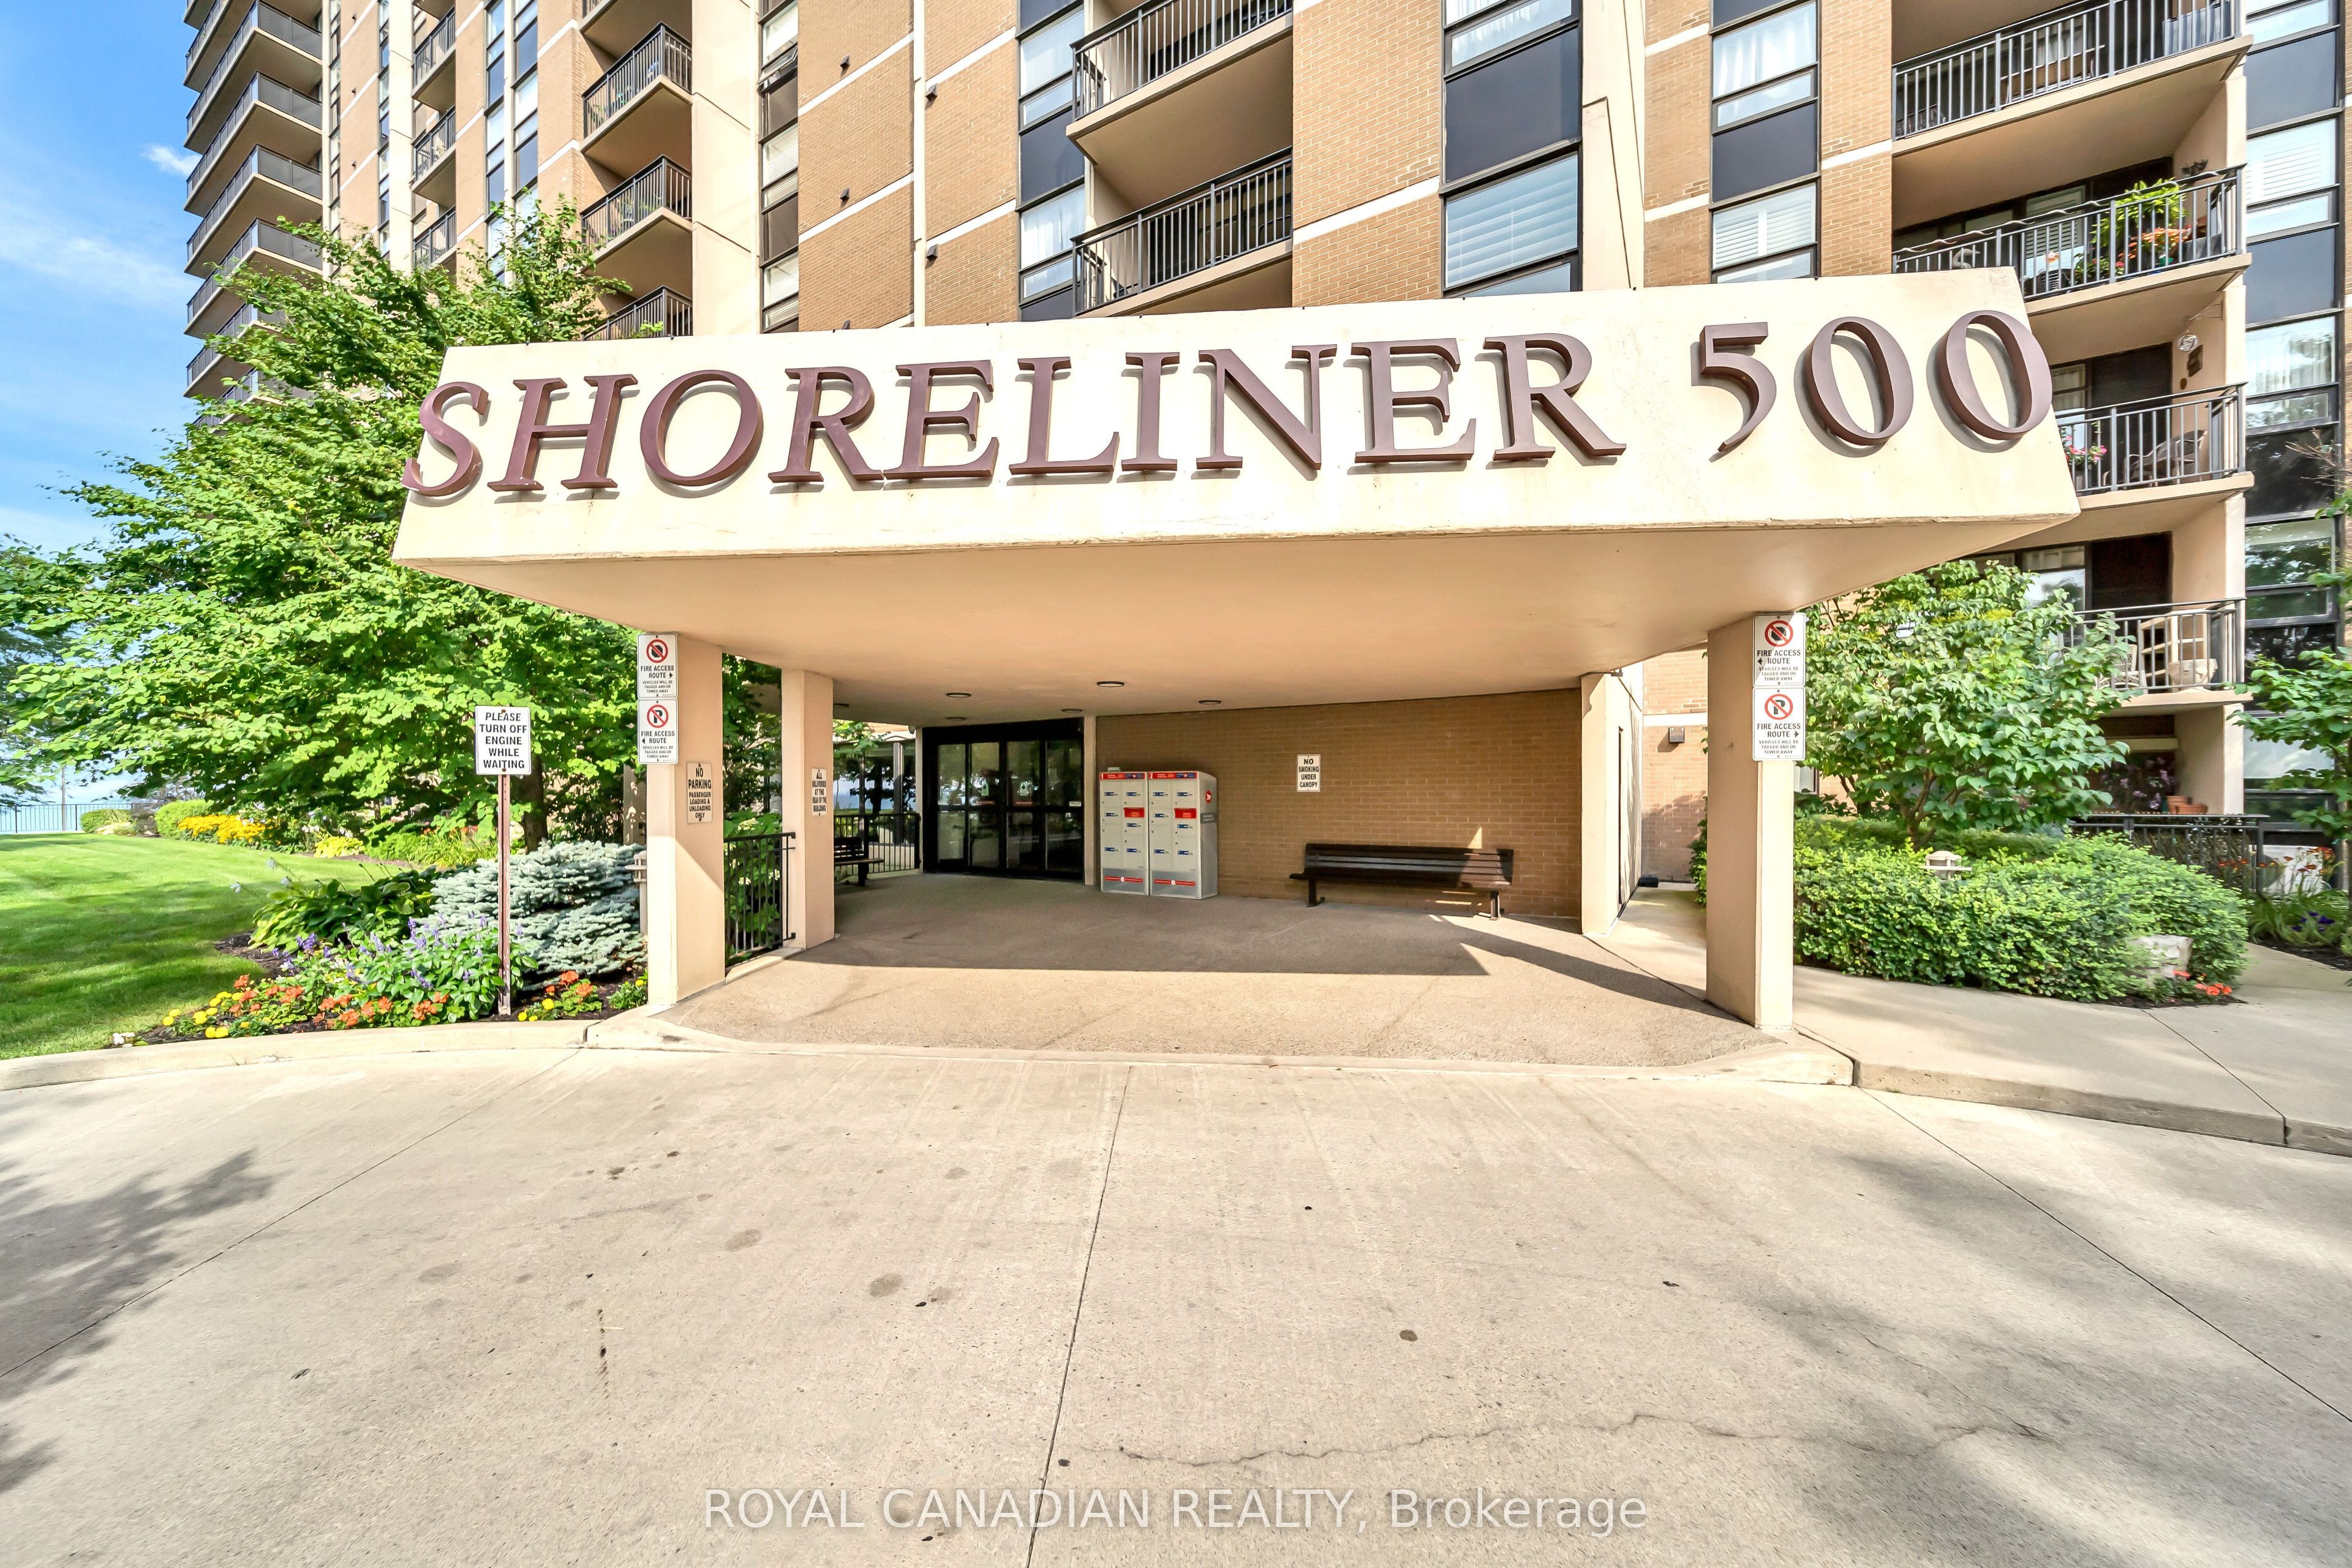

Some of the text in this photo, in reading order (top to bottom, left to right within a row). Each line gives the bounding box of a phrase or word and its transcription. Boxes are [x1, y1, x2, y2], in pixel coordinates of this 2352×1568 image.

[402, 309, 2052, 497] SHORELINER 500
[485, 712, 521, 722] PLEASE
[479, 724, 527, 734] TURN OFF
[485, 736, 522, 745] ENGINE
[488, 748, 519, 757] WHILE
[483, 760, 525, 769] WAITING
[695, 767, 704, 778] NO
[688, 779, 711, 789] PARKING
